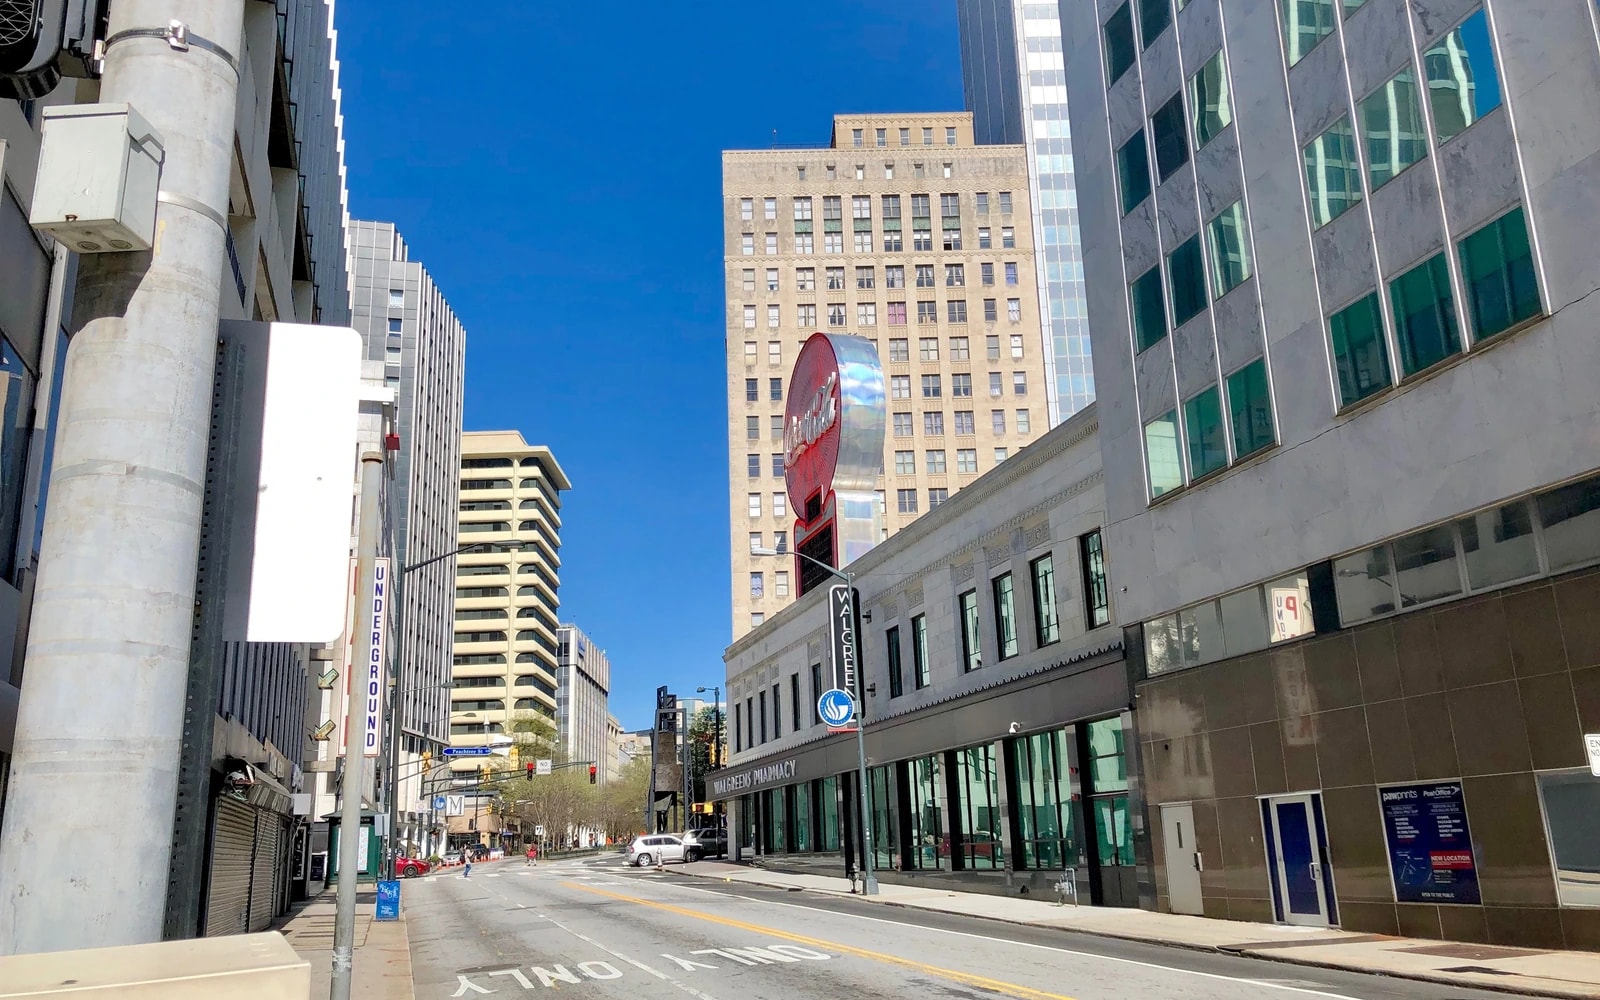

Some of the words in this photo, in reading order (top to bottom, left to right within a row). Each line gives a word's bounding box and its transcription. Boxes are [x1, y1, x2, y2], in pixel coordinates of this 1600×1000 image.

[366, 566, 385, 747] UNDERGROUND
[713, 771, 752, 794] WALGREENS
[753, 759, 797, 785] PHARMACY
[448, 796, 463, 815] M
[658, 944, 832, 972] ONLY
[449, 960, 623, 998] ONLY
